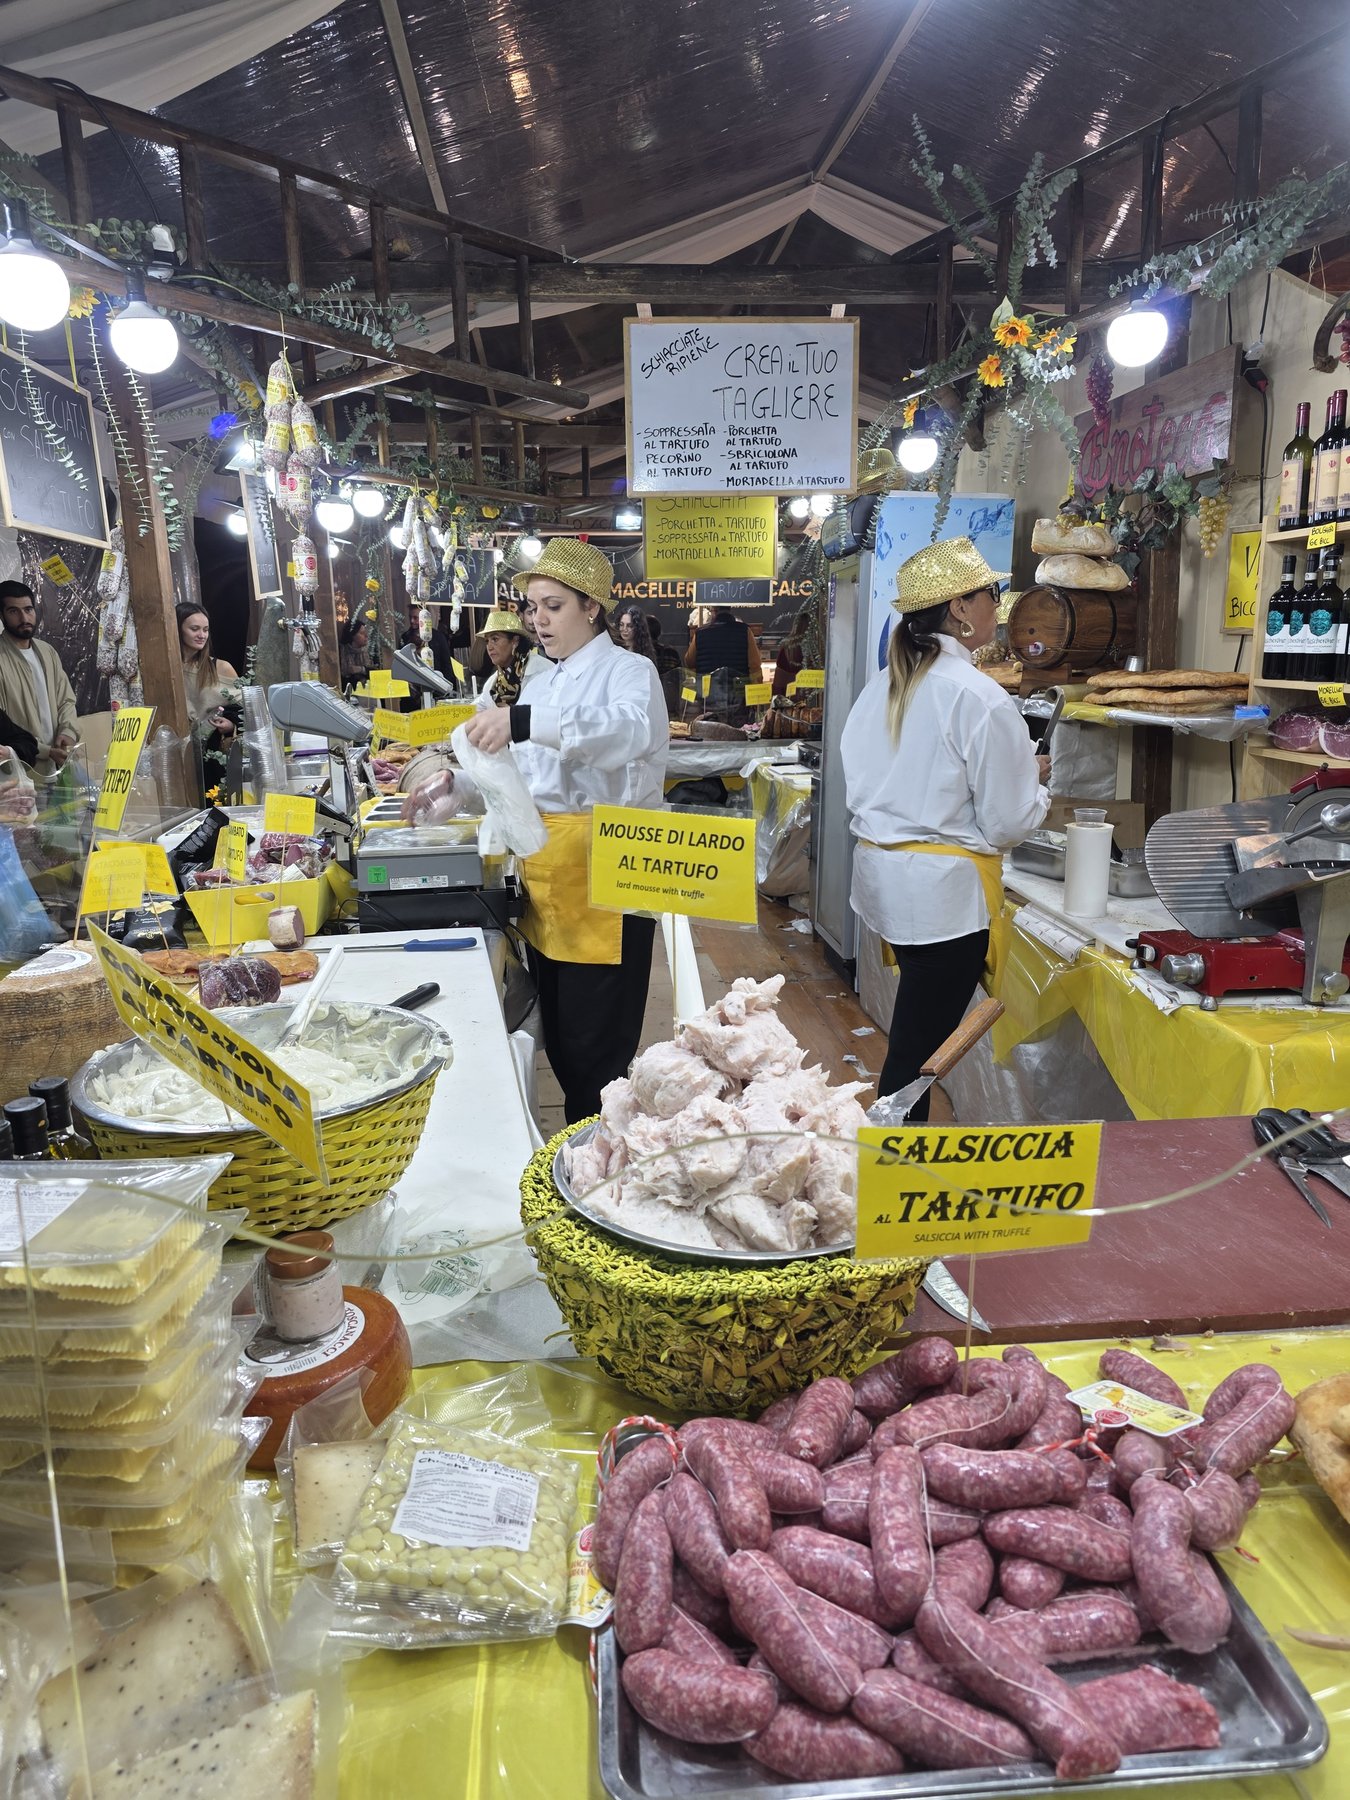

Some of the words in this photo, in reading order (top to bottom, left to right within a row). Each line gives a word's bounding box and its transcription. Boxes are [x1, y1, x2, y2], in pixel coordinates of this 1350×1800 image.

[640, 327, 704, 379] SCHIACCIATE
[665, 336, 720, 376] RIPIENE
[724, 343, 783, 378] CREA
[796, 341, 839, 376] TUO
[713, 383, 839, 422] TAGLIERE
[644, 440, 658, 449] AL
[660, 438, 710, 450] TARTUFO
[726, 437, 737, 446] AL
[738, 437, 782, 446] TARTUFO
[661, 467, 712, 477] TARTUFO
[729, 461, 742, 470] AL
[744, 461, 789, 470] TARTUFO
[804, 476, 845, 486] TARTUFO
[724, 516, 767, 530] TARTUFO
[728, 531, 768, 543] TARTUFO
[728, 546, 764, 558] TARTUFO
[609, 581, 694, 599] MACELLER
[700, 580, 755, 599] TARTUFO
[600, 822, 663, 843] MOUSSE
[667, 829, 683, 845] DI
[688, 831, 745, 851] LARDO
[618, 855, 637, 871] AL
[642, 857, 718, 880] TARTUFO
[632, 883, 660, 894] mousse
[662, 886, 679, 896] with
[681, 889, 705, 900] truffle
[160, 1020, 293, 1129] TARTUFO
[875, 1130, 1075, 1165] SALSICCIA
[874, 1213, 892, 1224] AL
[898, 1182, 1085, 1223] TARTUFO
[913, 1231, 961, 1242] SALSICCIA
[964, 1230, 989, 1241] WITH
[992, 1227, 1032, 1239] TRUFFLE
